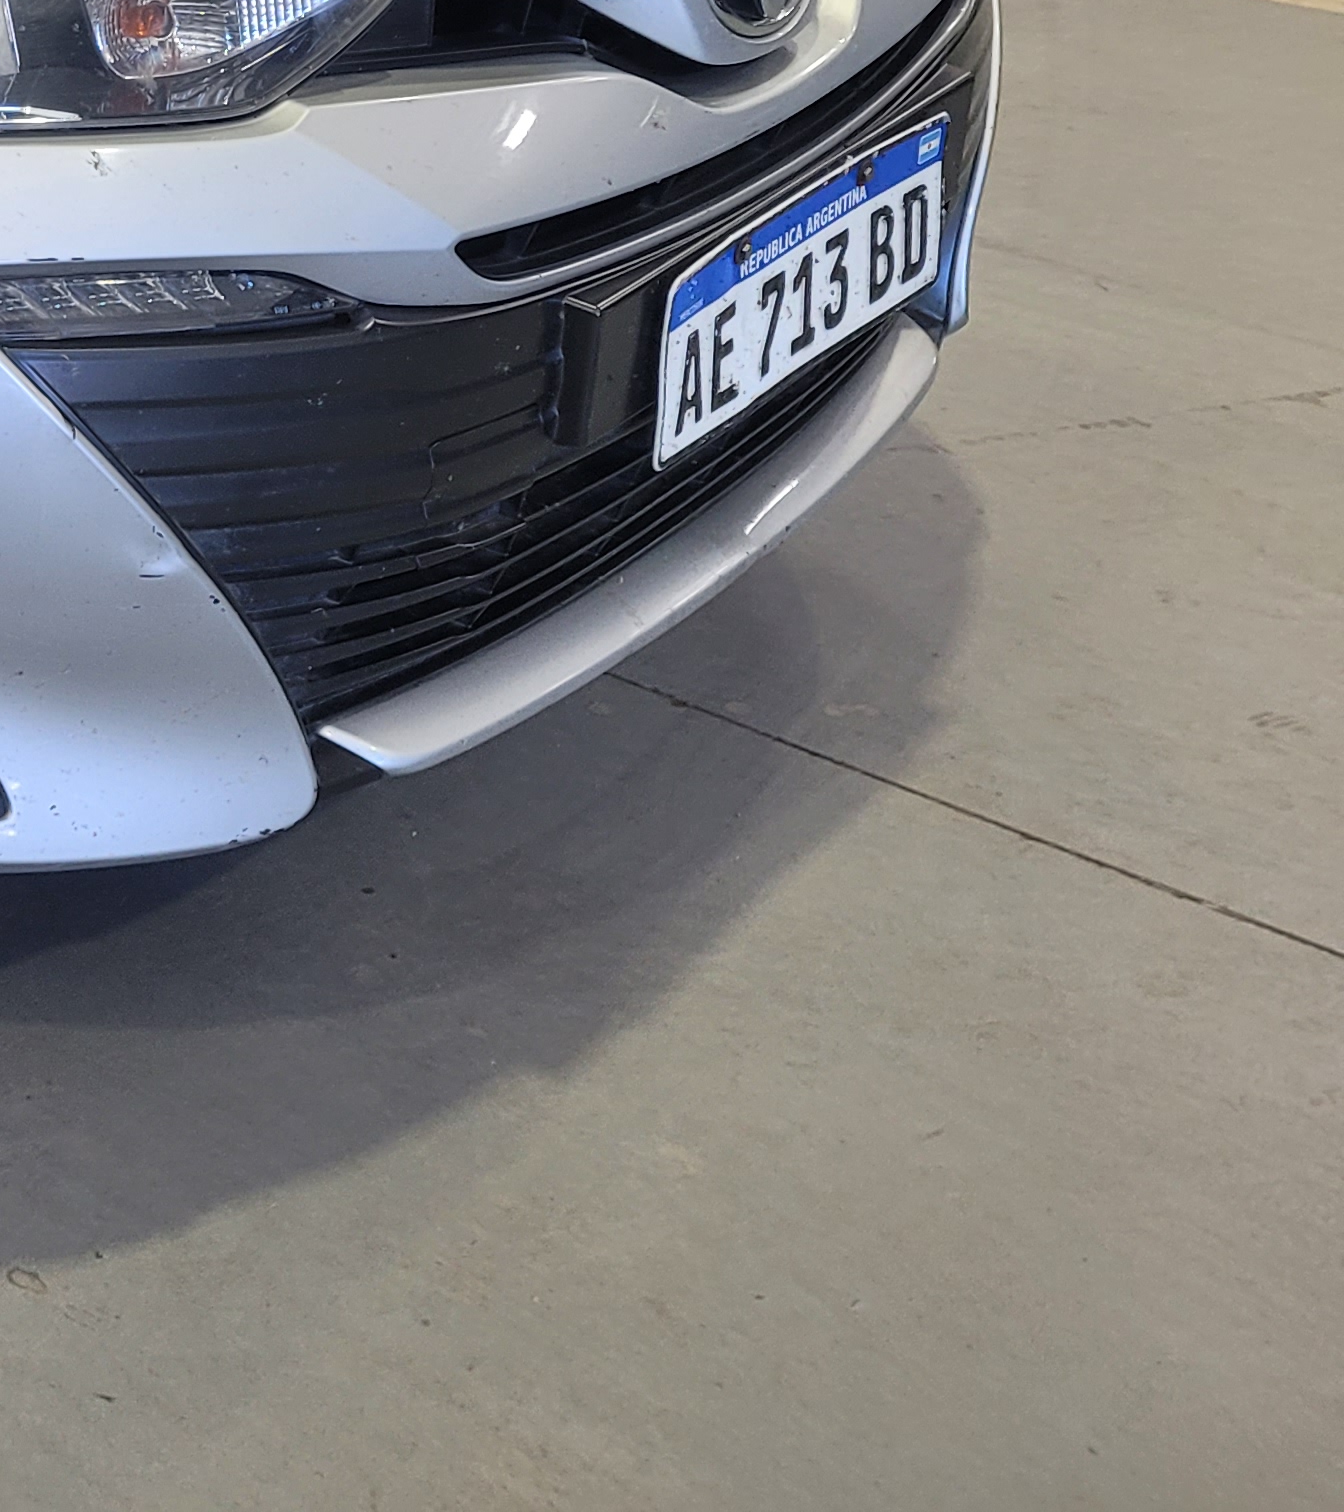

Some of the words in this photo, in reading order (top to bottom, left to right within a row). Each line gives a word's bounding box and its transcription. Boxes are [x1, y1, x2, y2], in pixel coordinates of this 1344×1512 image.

[675, 300, 739, 439] AE
[757, 227, 850, 382] 713
[868, 182, 928, 306] BD
[739, 223, 803, 279] REPUBLICA
[805, 184, 868, 237] ARGENTINA
